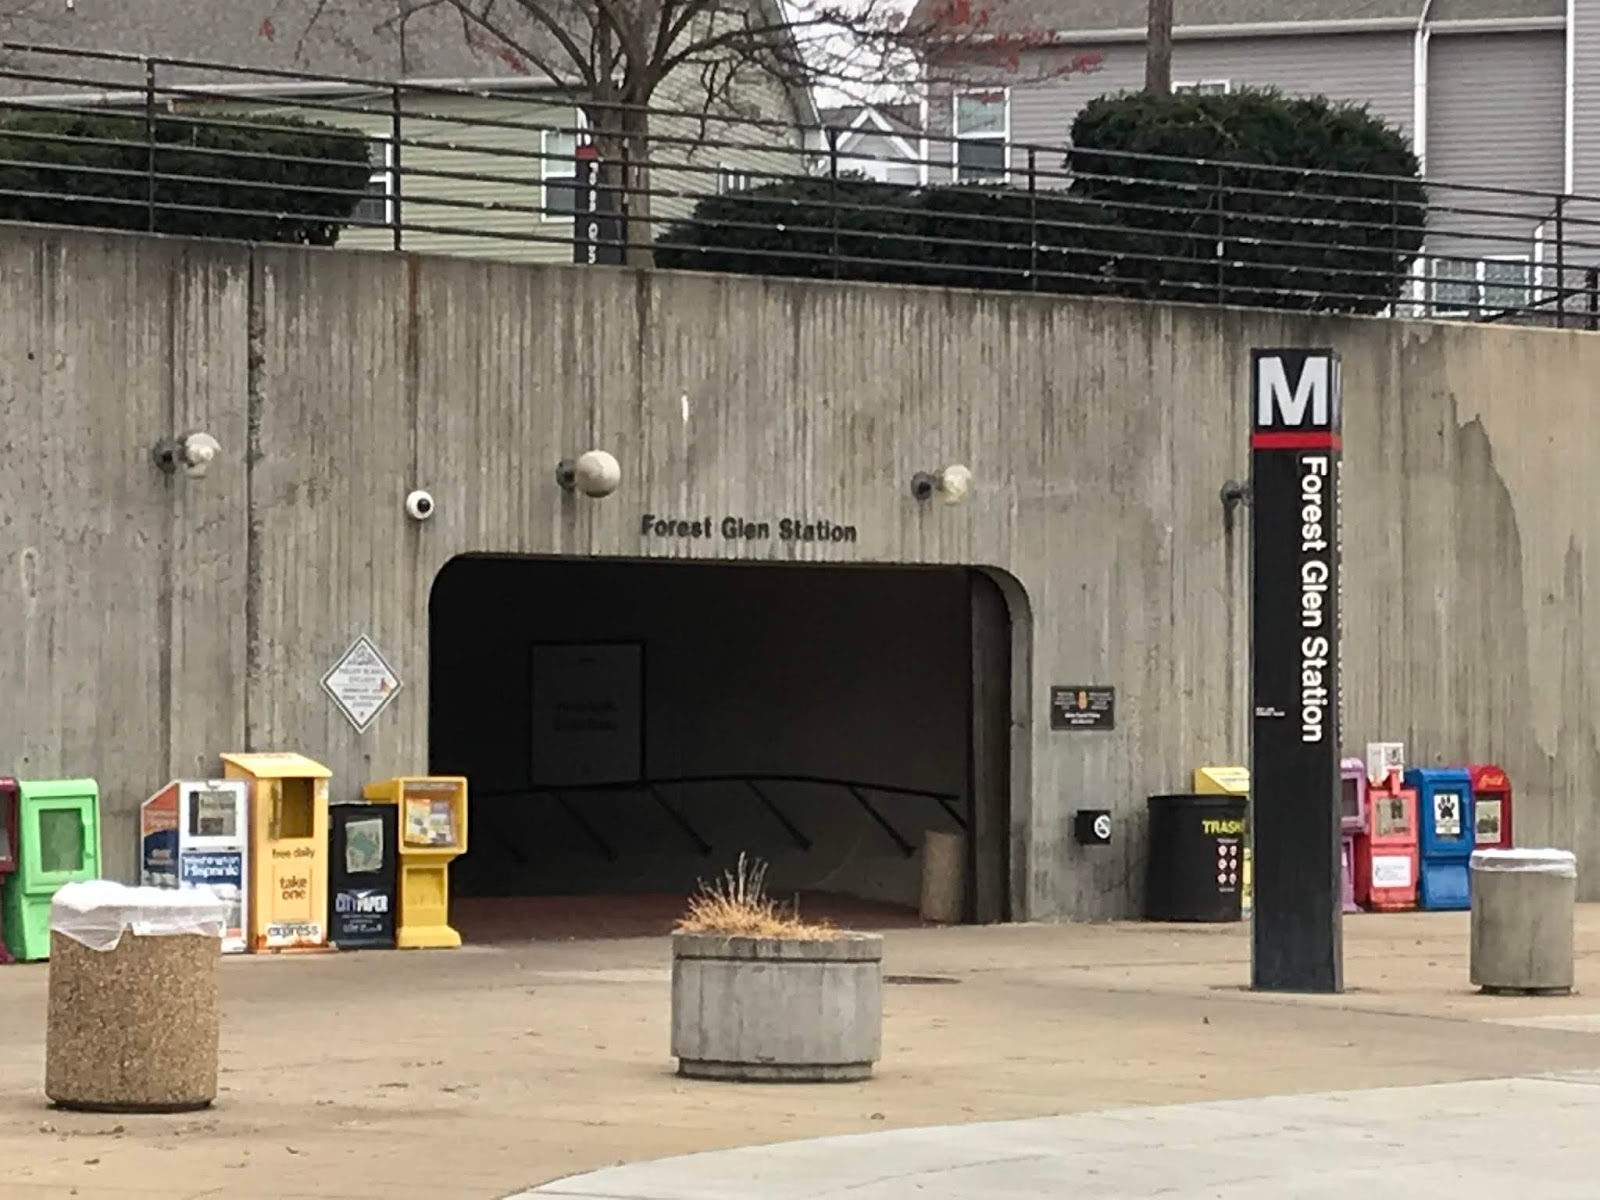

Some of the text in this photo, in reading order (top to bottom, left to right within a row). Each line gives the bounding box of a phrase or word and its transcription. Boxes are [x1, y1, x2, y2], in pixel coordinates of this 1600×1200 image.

[1258, 356, 1328, 426] M
[641, 514, 857, 542] Forest Glen Station
[1301, 456, 1329, 742] Forest Glen Station
[272, 848, 316, 860] free daily
[279, 875, 308, 890] take
[281, 889, 307, 901] one
[267, 924, 320, 939] express
